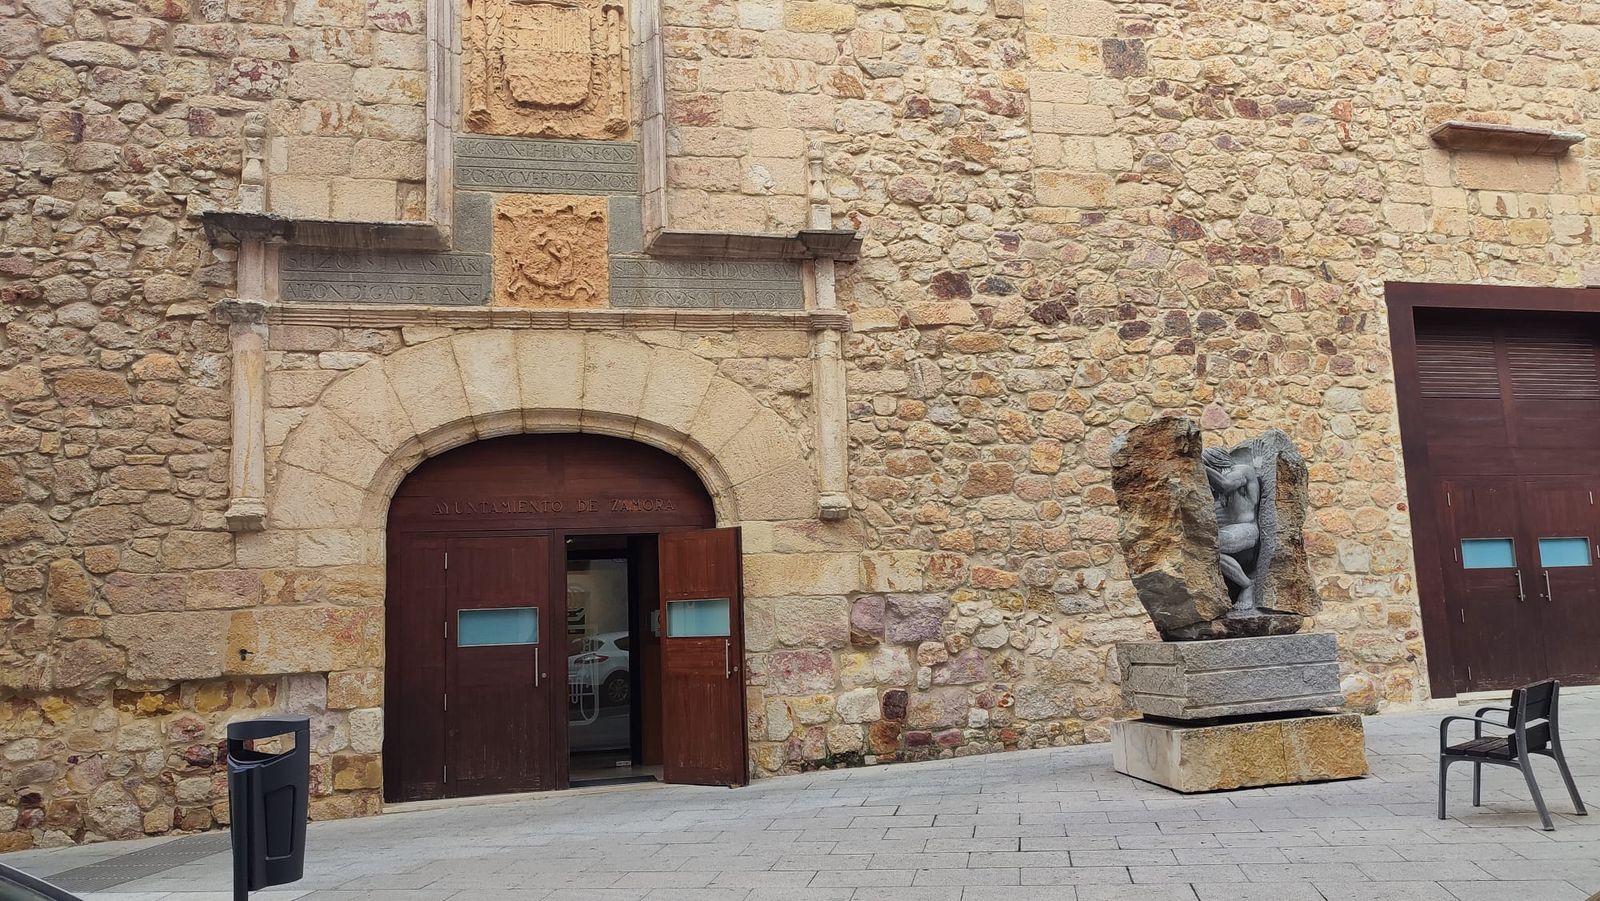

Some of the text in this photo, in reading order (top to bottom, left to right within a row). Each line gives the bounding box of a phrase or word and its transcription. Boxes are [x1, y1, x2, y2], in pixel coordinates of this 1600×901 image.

[432, 498, 678, 515] AYUNTAMIENTO DE ZAMORA
